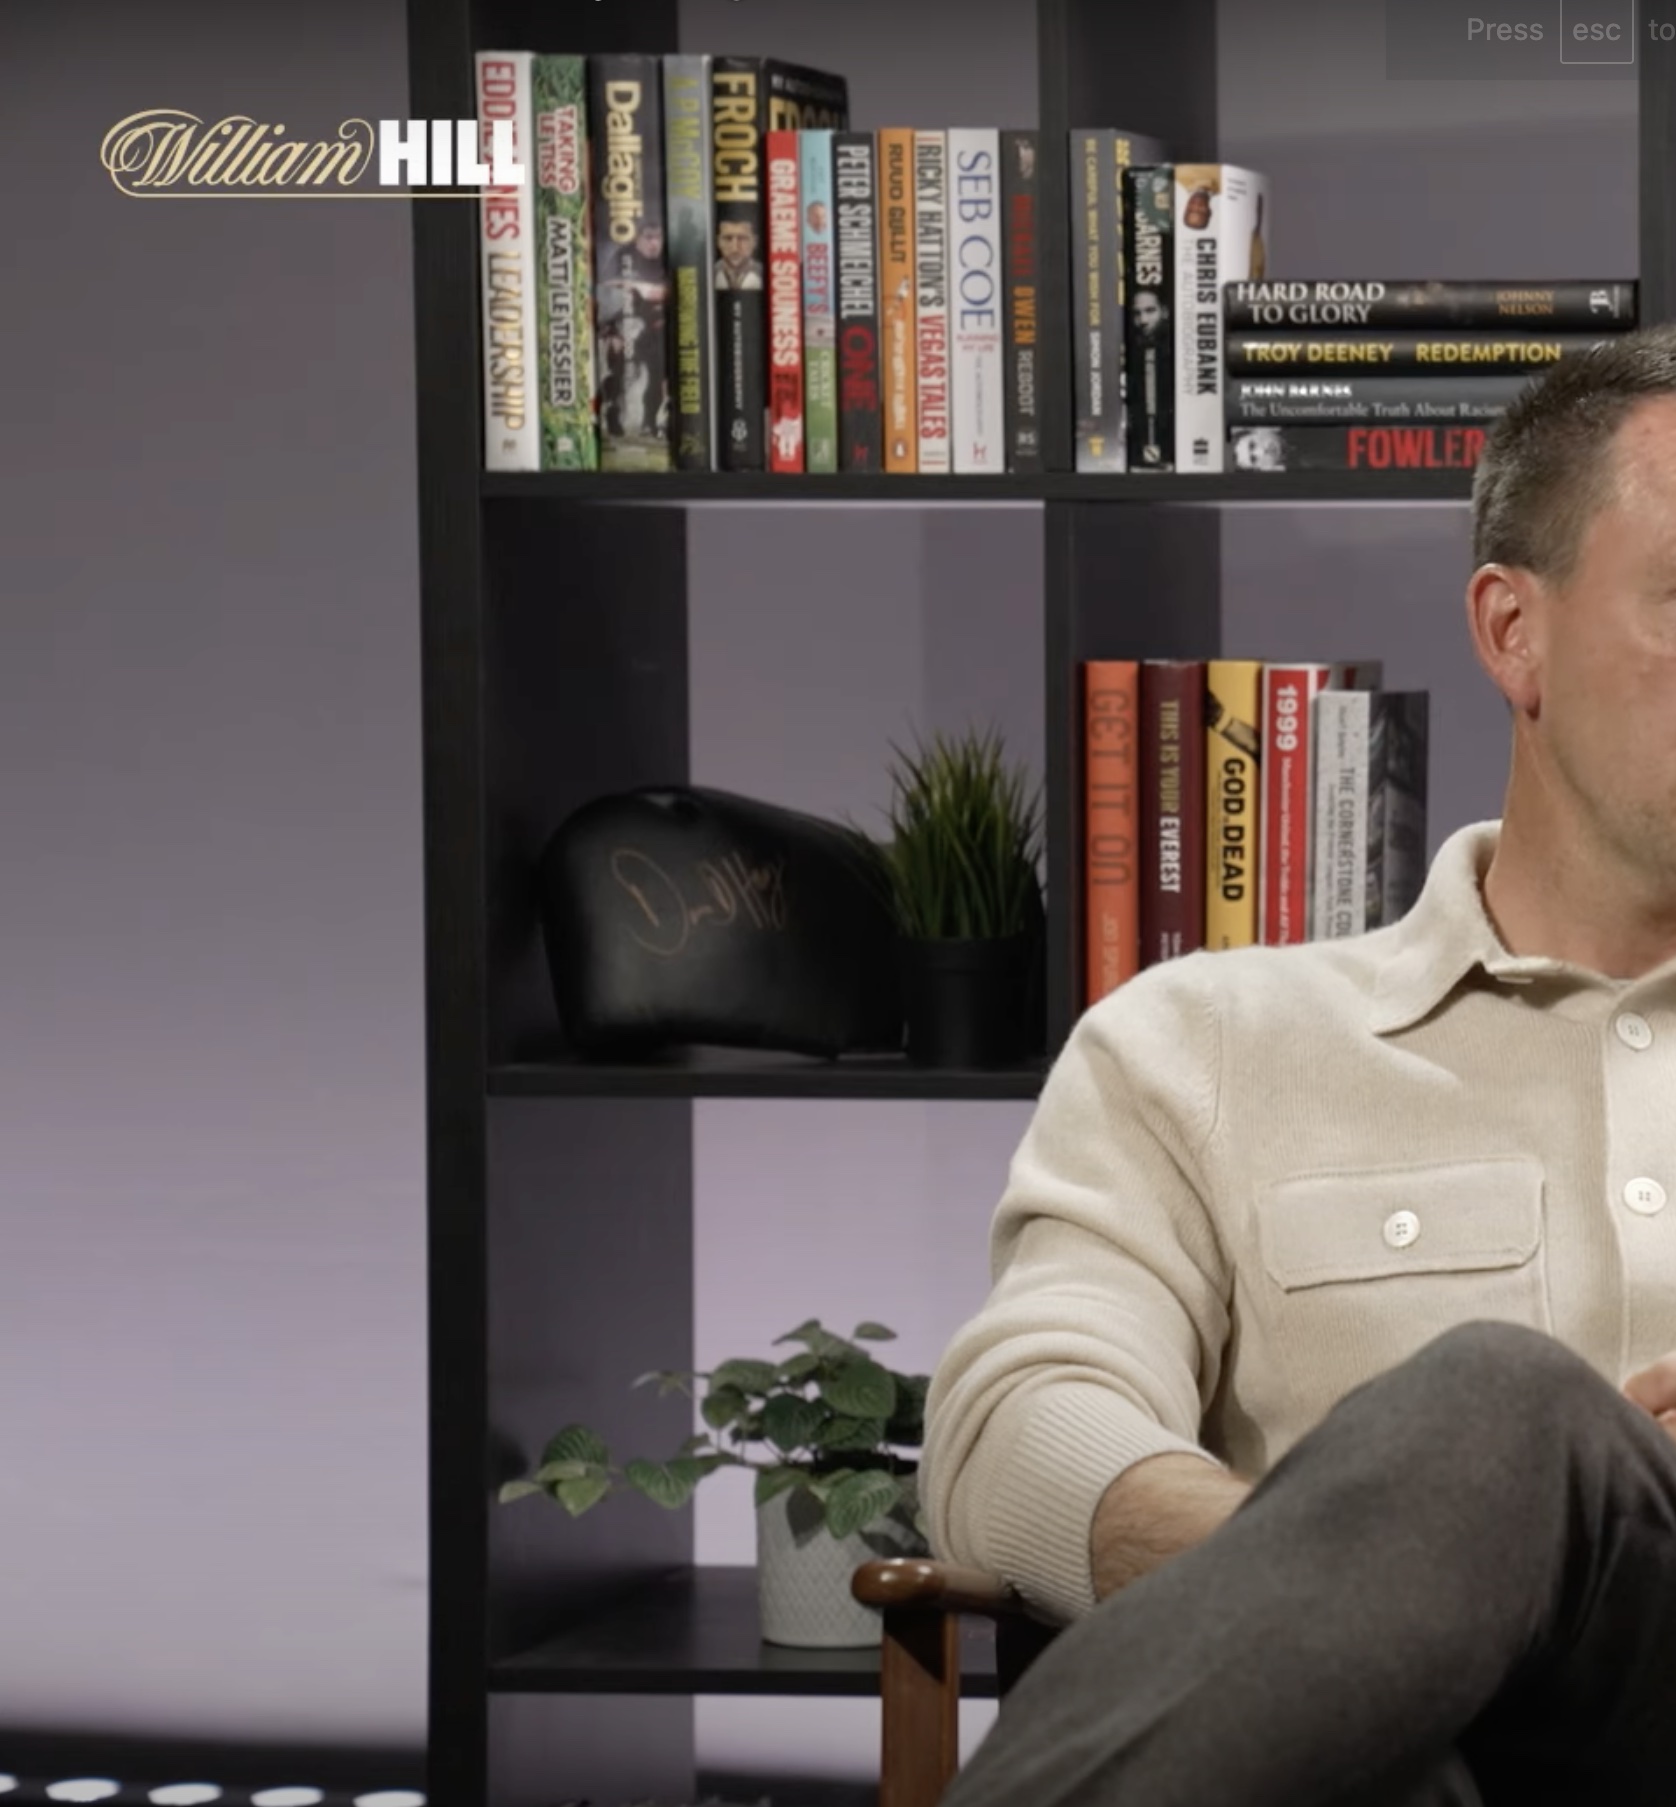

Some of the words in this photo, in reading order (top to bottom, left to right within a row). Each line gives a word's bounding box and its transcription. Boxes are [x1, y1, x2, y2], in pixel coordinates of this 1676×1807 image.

[539, 115, 555, 134] LE
[557, 106, 577, 193] TAKING
[713, 73, 758, 202] FROCH
[1086, 138, 1097, 153] BE
[540, 140, 557, 186] TISS
[602, 81, 643, 243] Dallaglio
[836, 145, 871, 199] PETER
[888, 143, 904, 201] RUUD
[917, 144, 943, 203] RICKY
[957, 151, 993, 223] SEB
[1087, 156, 1098, 208] CAREFUL
[769, 158, 798, 253] GRAEME
[1088, 210, 1099, 240] WHAT
[549, 219, 569, 284] MATT
[838, 203, 874, 319] SCHMEICHEL
[889, 206, 906, 264] GULLIT
[918, 211, 945, 308] HATTON'S
[1088, 244, 1099, 268] YOU
[807, 243, 829, 314] BEEFY'S
[959, 235, 995, 331] COE
[1088, 271, 1099, 300] WISH
[1196, 238, 1217, 304] CHRIS
[1237, 282, 1308, 302] HARD
[1315, 282, 1386, 302] ROAD
[552, 292, 570, 315] LE
[772, 260, 800, 366] SOUNESS
[1013, 286, 1037, 344] OWEN
[1089, 301, 1100, 327] FOR
[1248, 303, 1283, 323] TO
[1289, 303, 1373, 324] GLORY
[1498, 303, 1555, 315] NELSON
[488, 250, 526, 431] LEADERSHIP
[553, 322, 572, 402] TISSIER
[841, 325, 878, 413] ONE
[919, 314, 945, 379] VEGAS
[1090, 331, 1101, 369] SIMON
[1197, 312, 1217, 395] EUBANK
[1242, 342, 1302, 362] TROY
[1307, 342, 1394, 362] DEENEY
[1415, 342, 1562, 362] REDEMPTION
[920, 383, 946, 439] TALES
[1017, 349, 1035, 416] REBOOT
[1090, 371, 1102, 416] JORDAN
[1240, 384, 1285, 399] JOHN
[1240, 403, 1265, 417] The
[1269, 403, 1368, 417] Uncomfortable
[1372, 403, 1409, 417] Truth
[1414, 403, 1455, 417] About
[1347, 428, 1485, 468] FOWLER
[1091, 688, 1131, 766] GET
[1160, 700, 1180, 740] THIS
[1276, 684, 1298, 751] 1999
[1160, 745, 1180, 763] IS
[1338, 767, 1355, 795] THE
[1091, 783, 1131, 818] IT
[1160, 766, 1180, 813] YOUR
[1223, 758, 1246, 815] GOD
[1160, 816, 1181, 893] EVEREST
[1222, 825, 1245, 903] DEAD
[1337, 798, 1356, 906] CORNERSTONE
